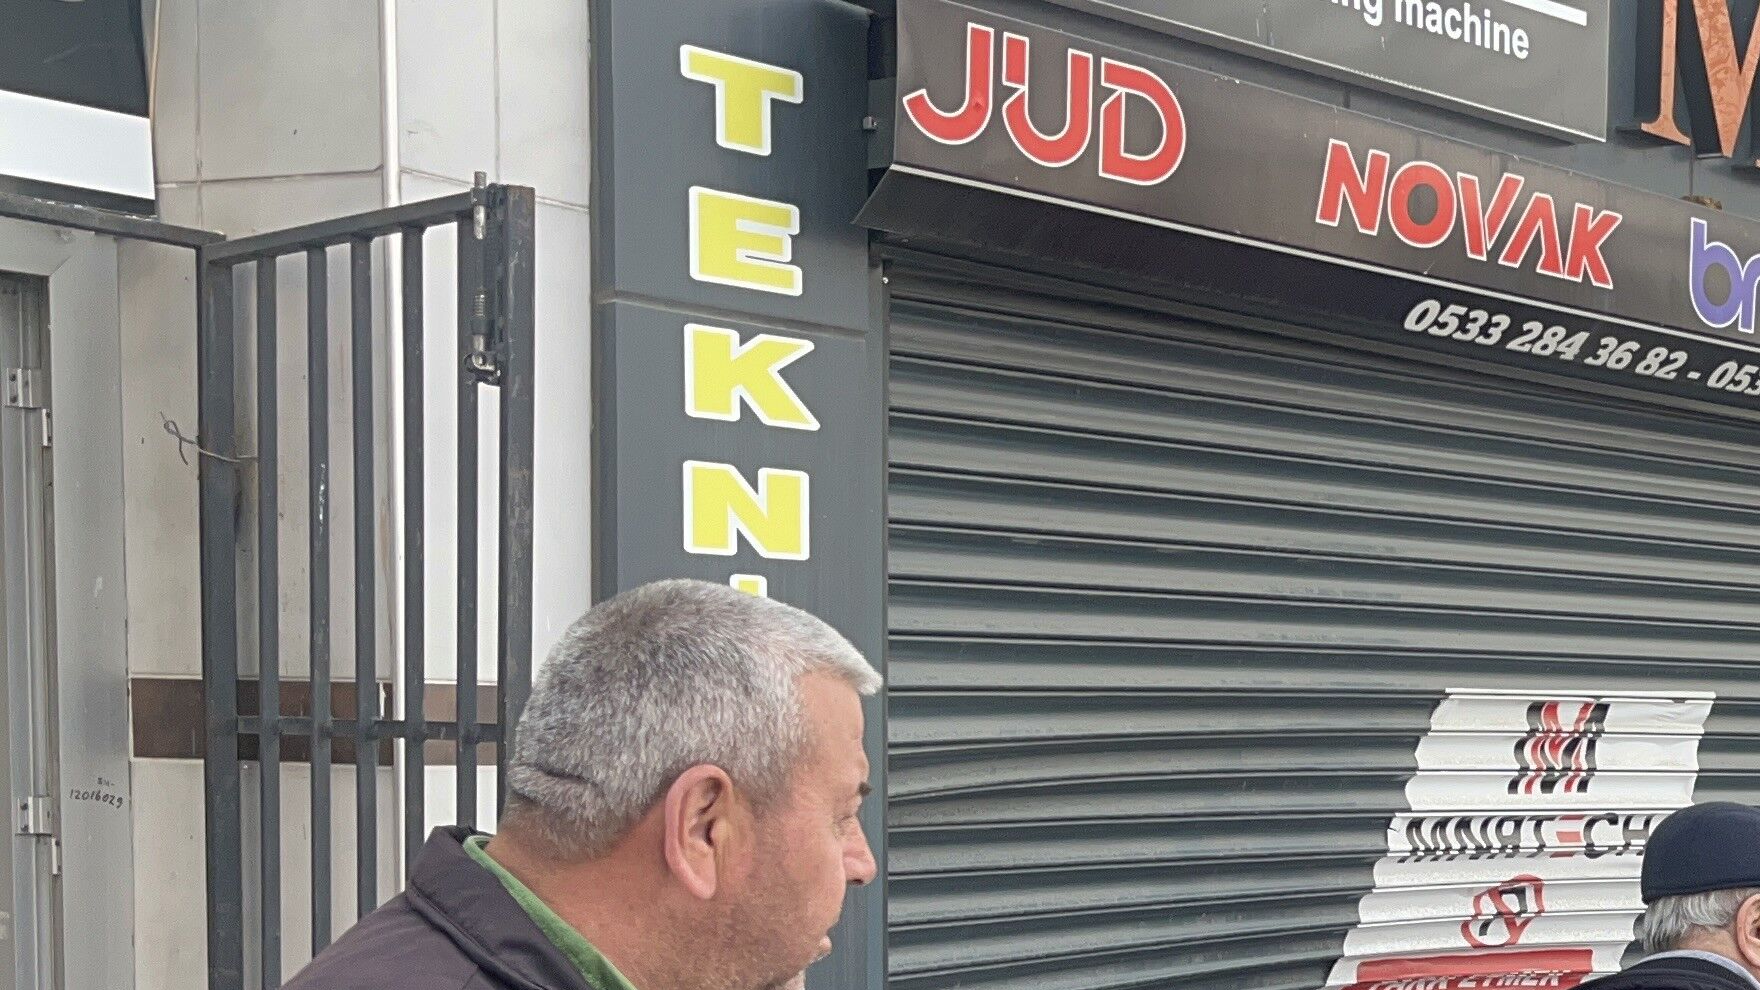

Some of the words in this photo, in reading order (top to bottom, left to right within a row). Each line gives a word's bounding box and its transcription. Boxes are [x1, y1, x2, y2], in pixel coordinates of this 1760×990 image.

[902, 22, 1186, 187] JUD
[1395, 0, 1530, 60] machine
[1315, 138, 1623, 290] NOVAK
[679, 44, 820, 600] TEKN
[1403, 298, 1511, 346] 0533
[1505, 320, 1591, 361] 284
[1583, 336, 1641, 370] 36
[1634, 346, 1688, 380] 82
